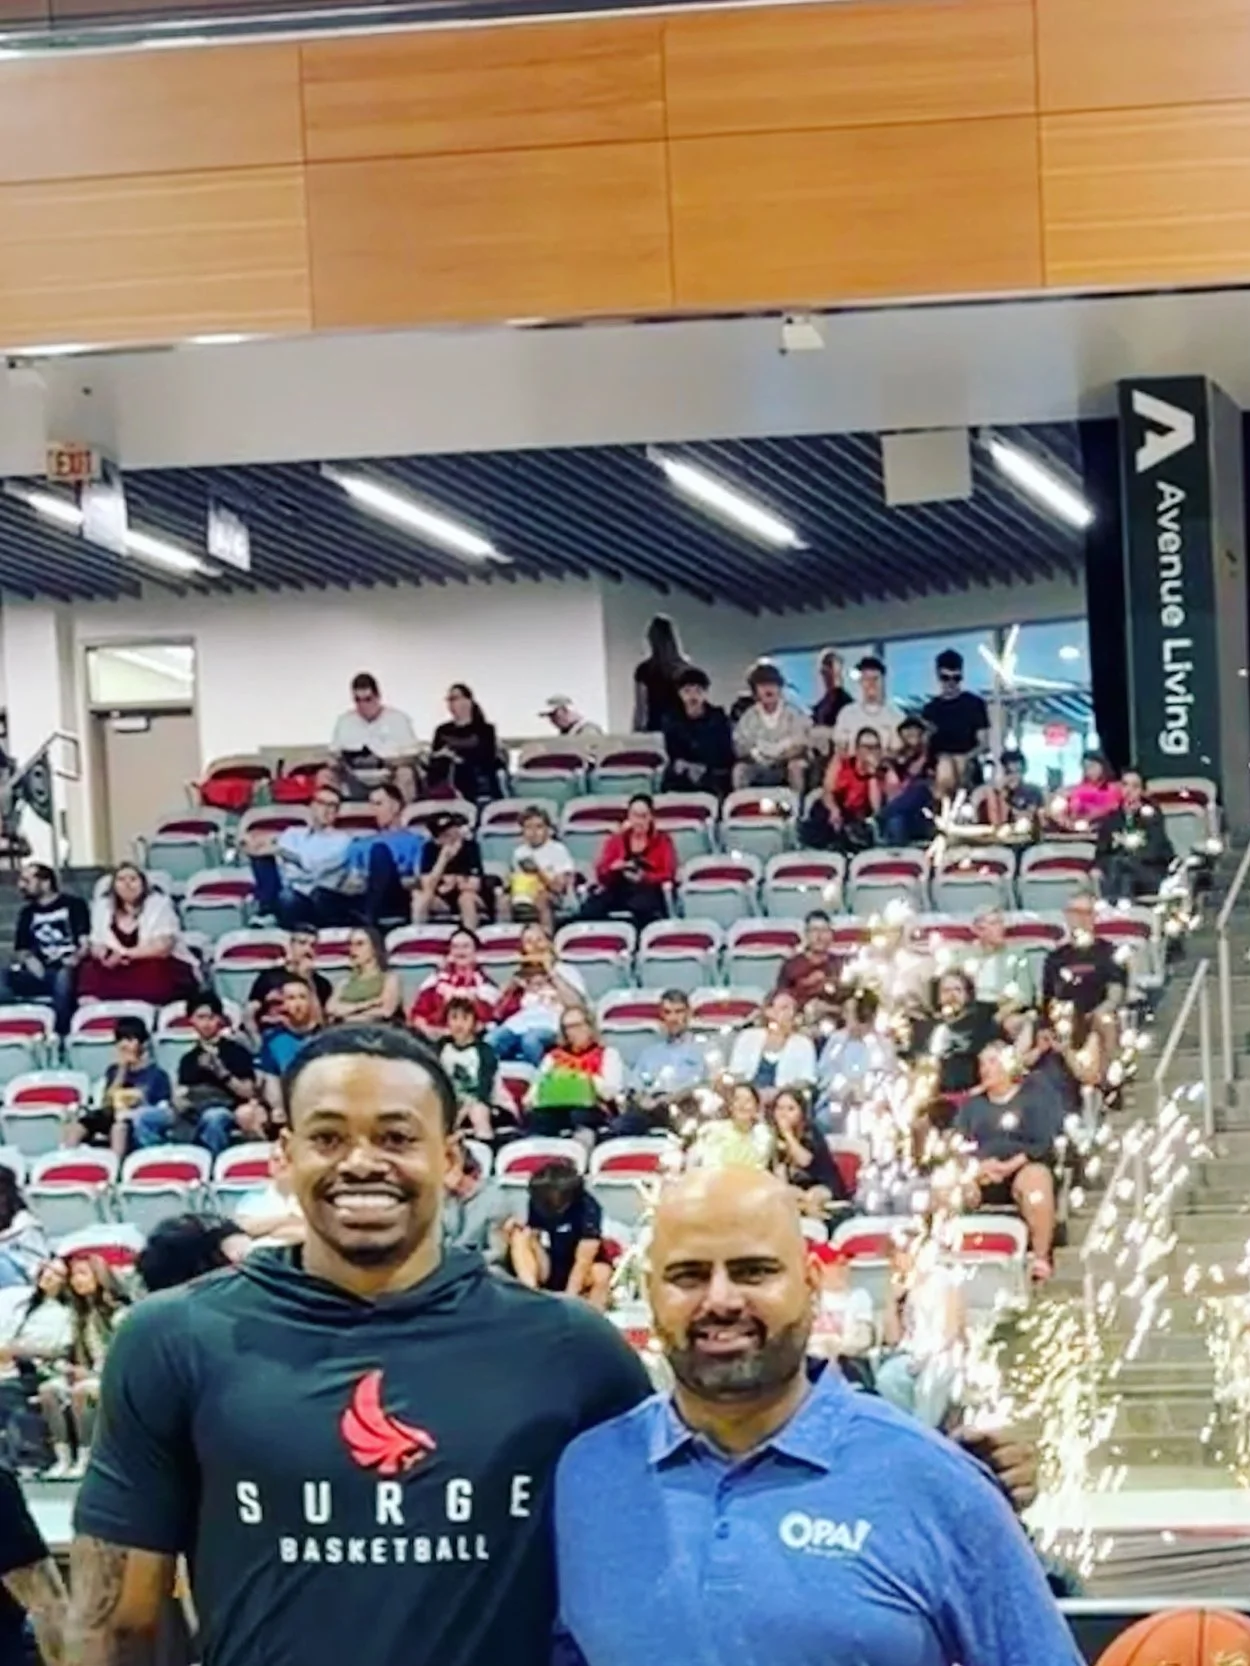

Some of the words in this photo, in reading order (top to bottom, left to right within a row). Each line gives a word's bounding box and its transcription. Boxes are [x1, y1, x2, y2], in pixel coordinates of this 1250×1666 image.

[1155, 480, 1187, 628] Avenue
[1158, 637, 1195, 756] Living
[236, 1474, 532, 1525] SURGE
[278, 1535, 490, 1563] BASKETBALL
